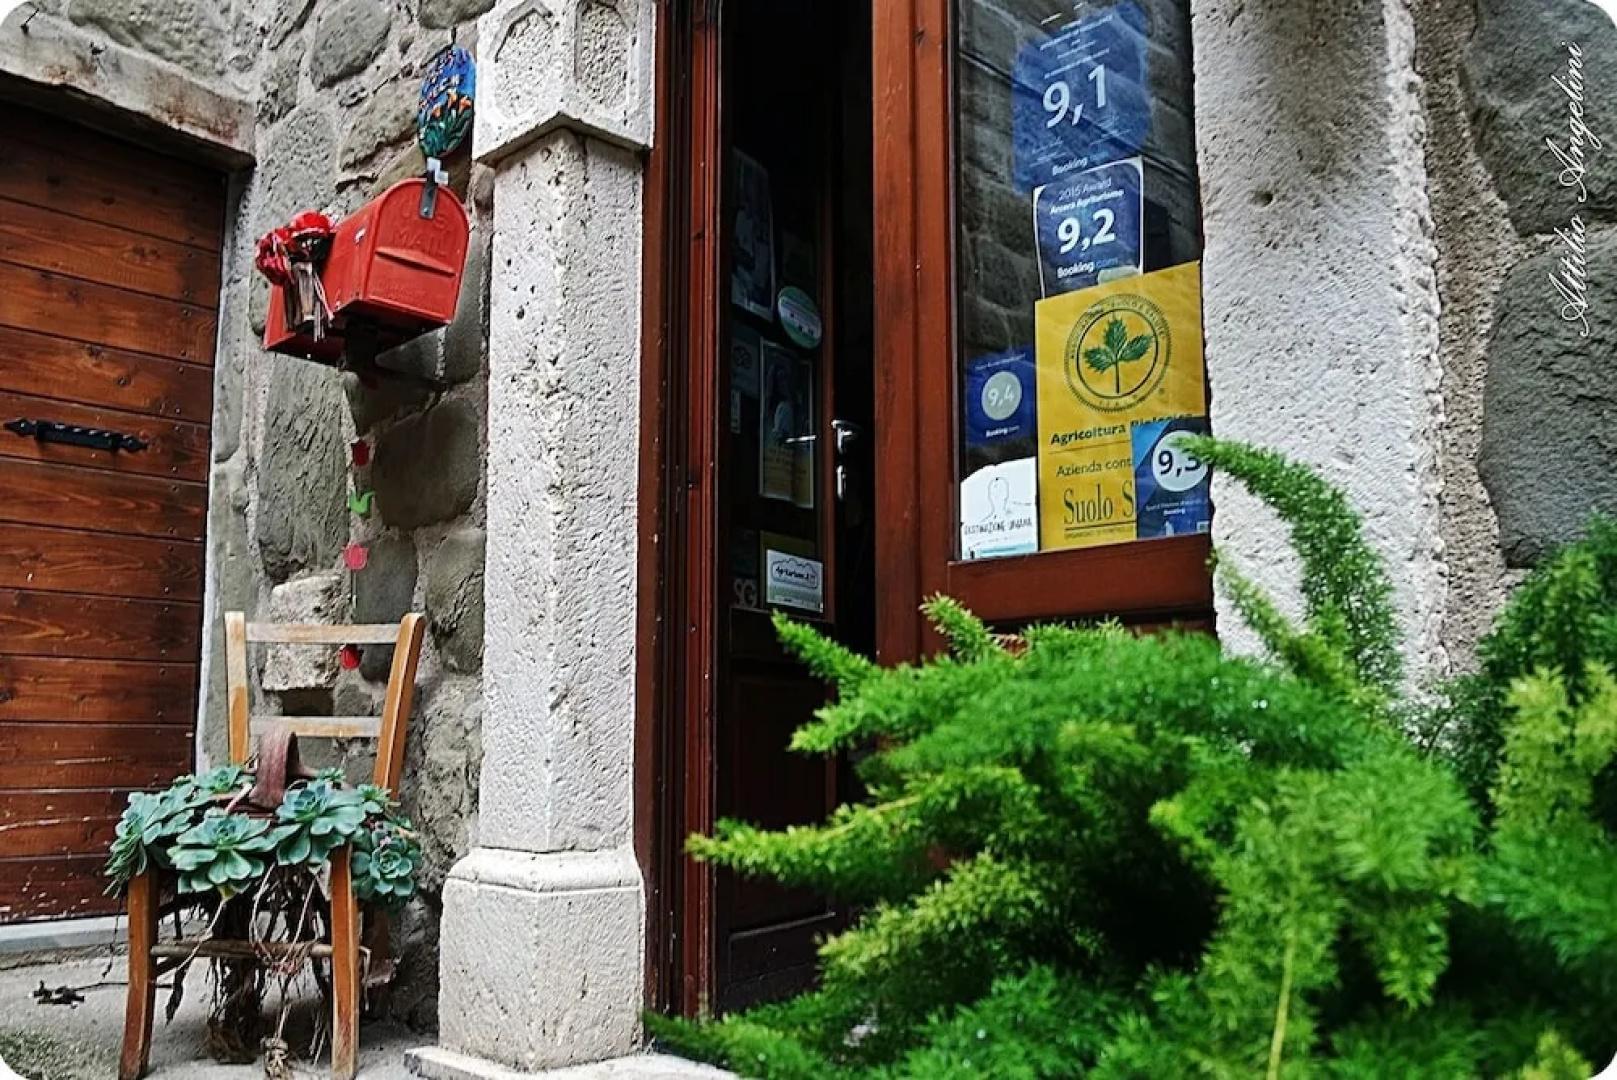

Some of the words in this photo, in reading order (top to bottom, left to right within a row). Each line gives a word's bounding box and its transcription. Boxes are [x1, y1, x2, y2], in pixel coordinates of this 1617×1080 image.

[1042, 65, 1107, 128] 9,1
[1059, 185, 1080, 201] 2015
[1057, 208, 1116, 254] 9,2
[988, 384, 1014, 406] 9,4
[1051, 423, 1126, 445] Agricoltura
[1056, 461, 1101, 477] Azienda
[1063, 484, 1113, 525] Suolo
